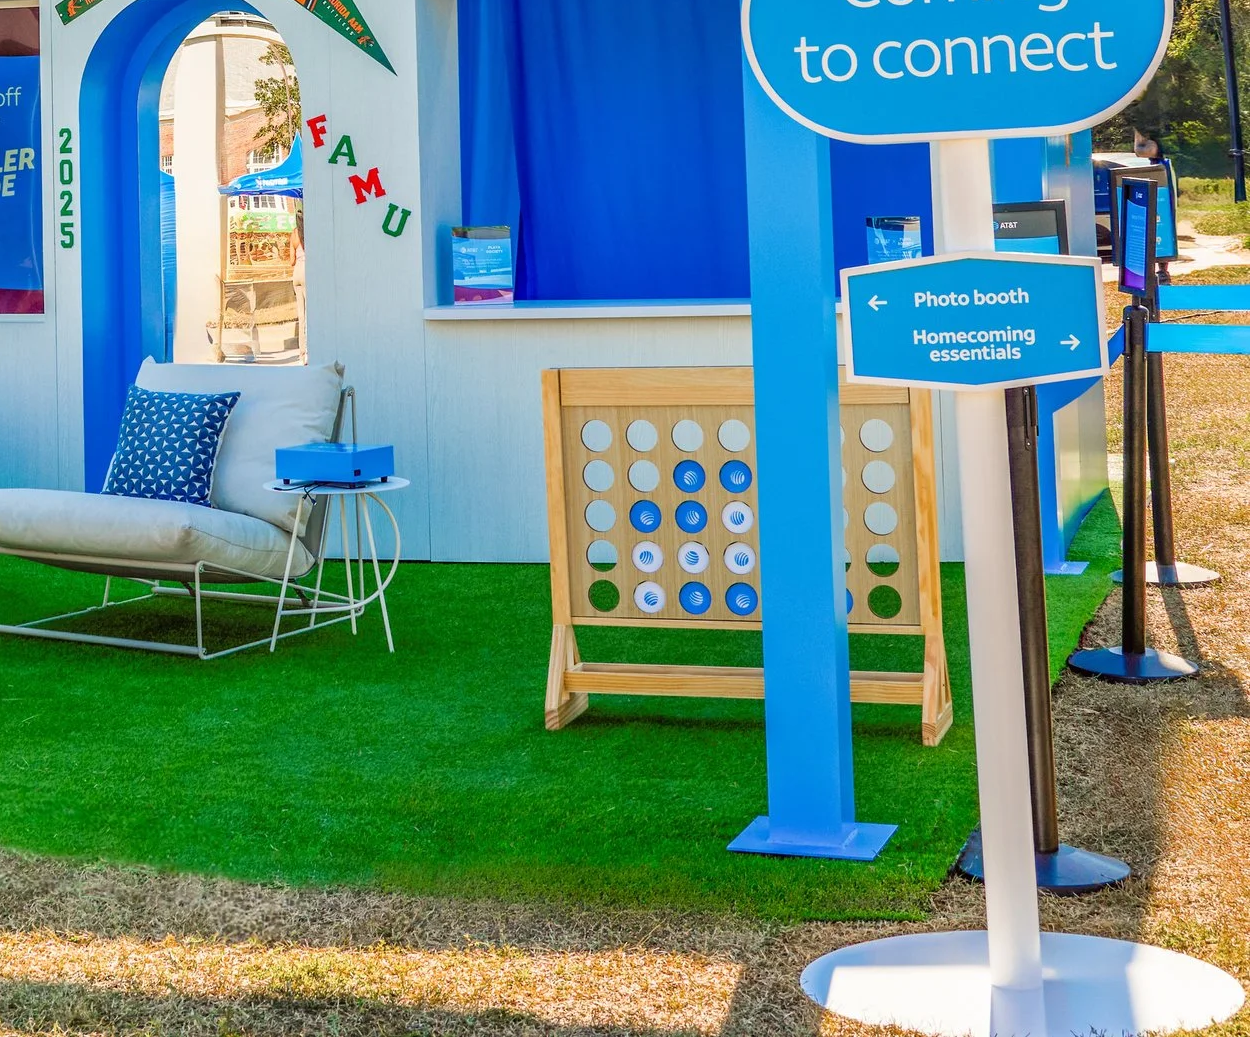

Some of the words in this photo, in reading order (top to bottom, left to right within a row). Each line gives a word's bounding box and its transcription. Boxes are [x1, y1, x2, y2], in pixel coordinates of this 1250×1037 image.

[347, 17, 364, 34] A&M
[793, 36, 858, 84] to
[872, 21, 1118, 79] connect
[58, 127, 75, 249] 2025
[1000, 221, 1018, 229] AT&T
[914, 291, 970, 308] Photo
[973, 287, 1030, 305] booth
[913, 325, 1036, 346] Homecoming
[929, 343, 1022, 362] essentials
